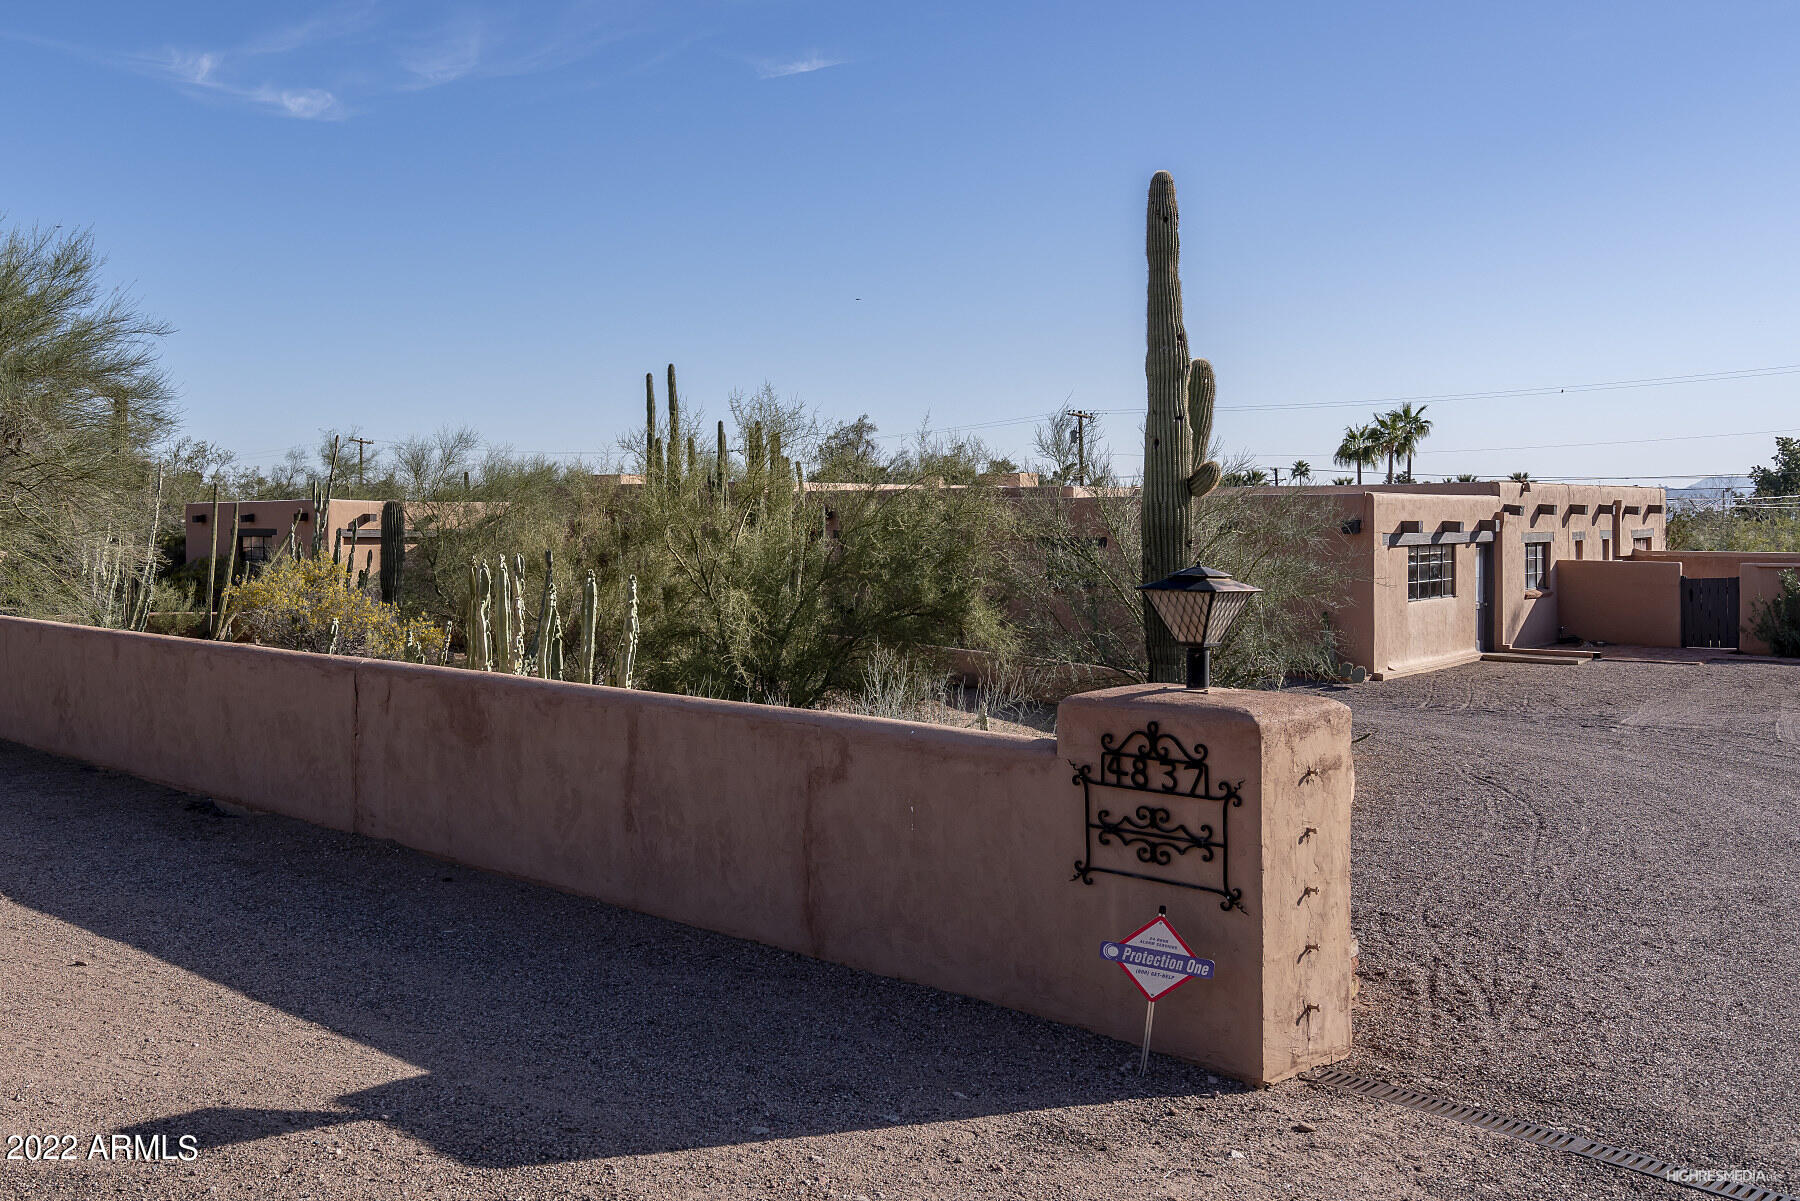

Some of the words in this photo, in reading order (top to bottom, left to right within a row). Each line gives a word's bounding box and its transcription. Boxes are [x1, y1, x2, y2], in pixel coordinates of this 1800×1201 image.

[1106, 756, 1204, 796] 4837
[1122, 947, 1183, 971] Protection
[1186, 959, 1210, 976] One
